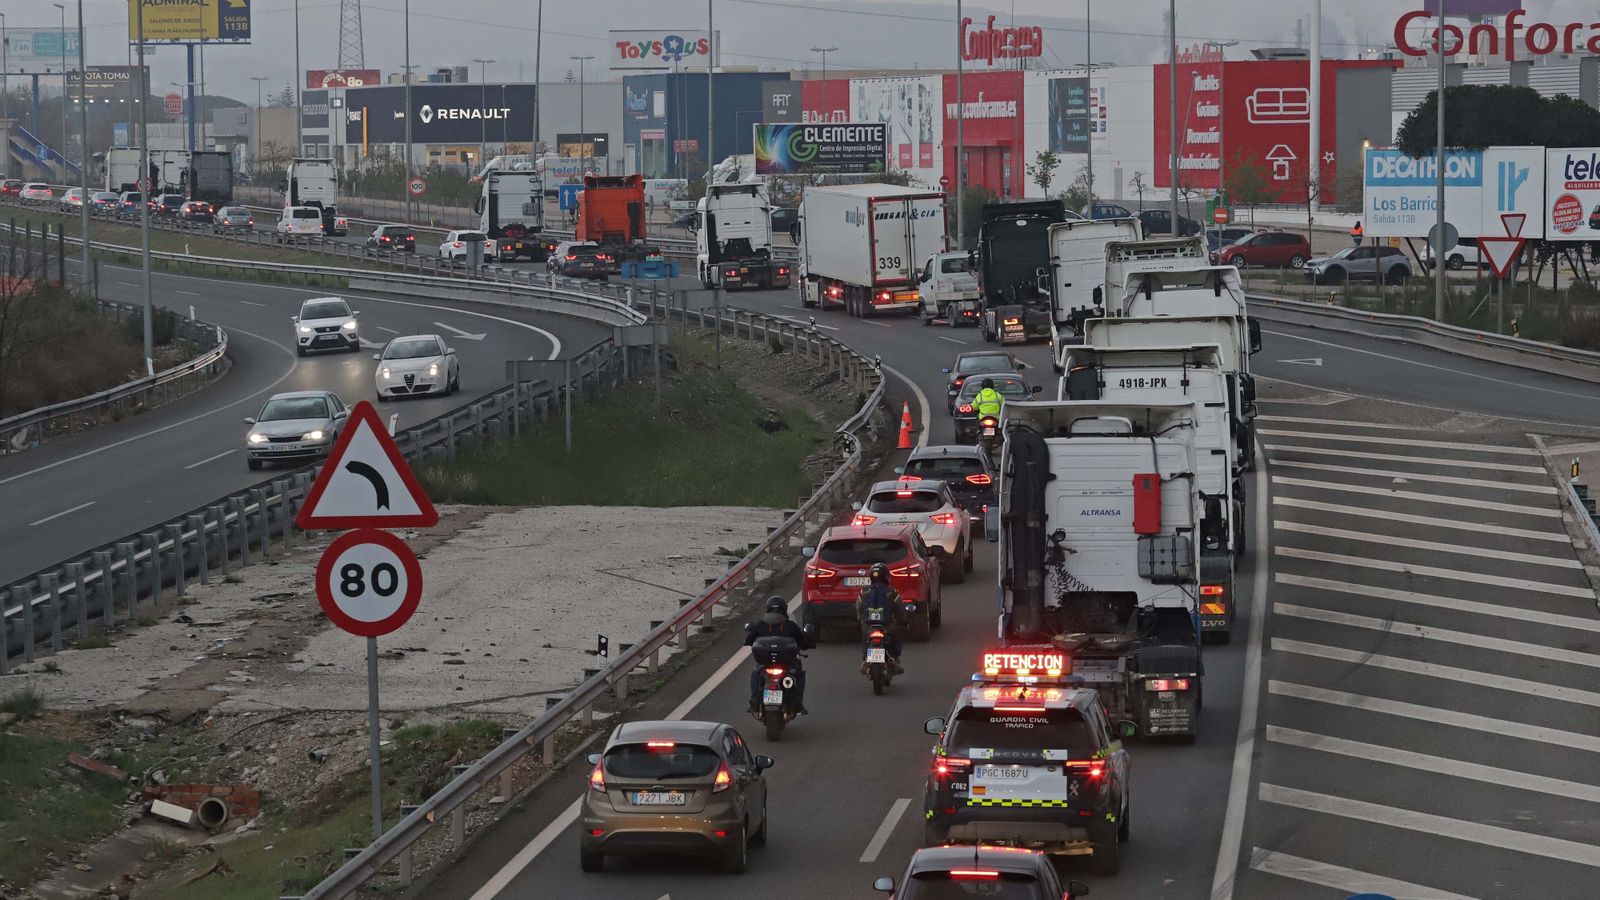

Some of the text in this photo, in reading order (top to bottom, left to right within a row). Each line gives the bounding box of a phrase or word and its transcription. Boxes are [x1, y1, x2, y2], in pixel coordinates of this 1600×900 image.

[961, 15, 1043, 66] Conforama
[70, 72, 102, 80] TOOTA
[437, 109, 511, 119] RENAULT
[804, 126, 883, 142] CLEMENTE
[819, 144, 834, 152] Centro
[843, 144, 866, 153] Impresión
[867, 143, 883, 153] Digital
[1373, 195, 1445, 211] Los Barrio
[1373, 215, 1416, 223] Salida 113B
[879, 256, 901, 269] 339
[1119, 377, 1167, 388] 4918-JPX
[339, 562, 399, 598] 80
[870, 612, 881, 620] 83
[984, 653, 1063, 669] RETENCION
[981, 768, 999, 777] PGC
[639, 794, 682, 803] 7271 JBK
